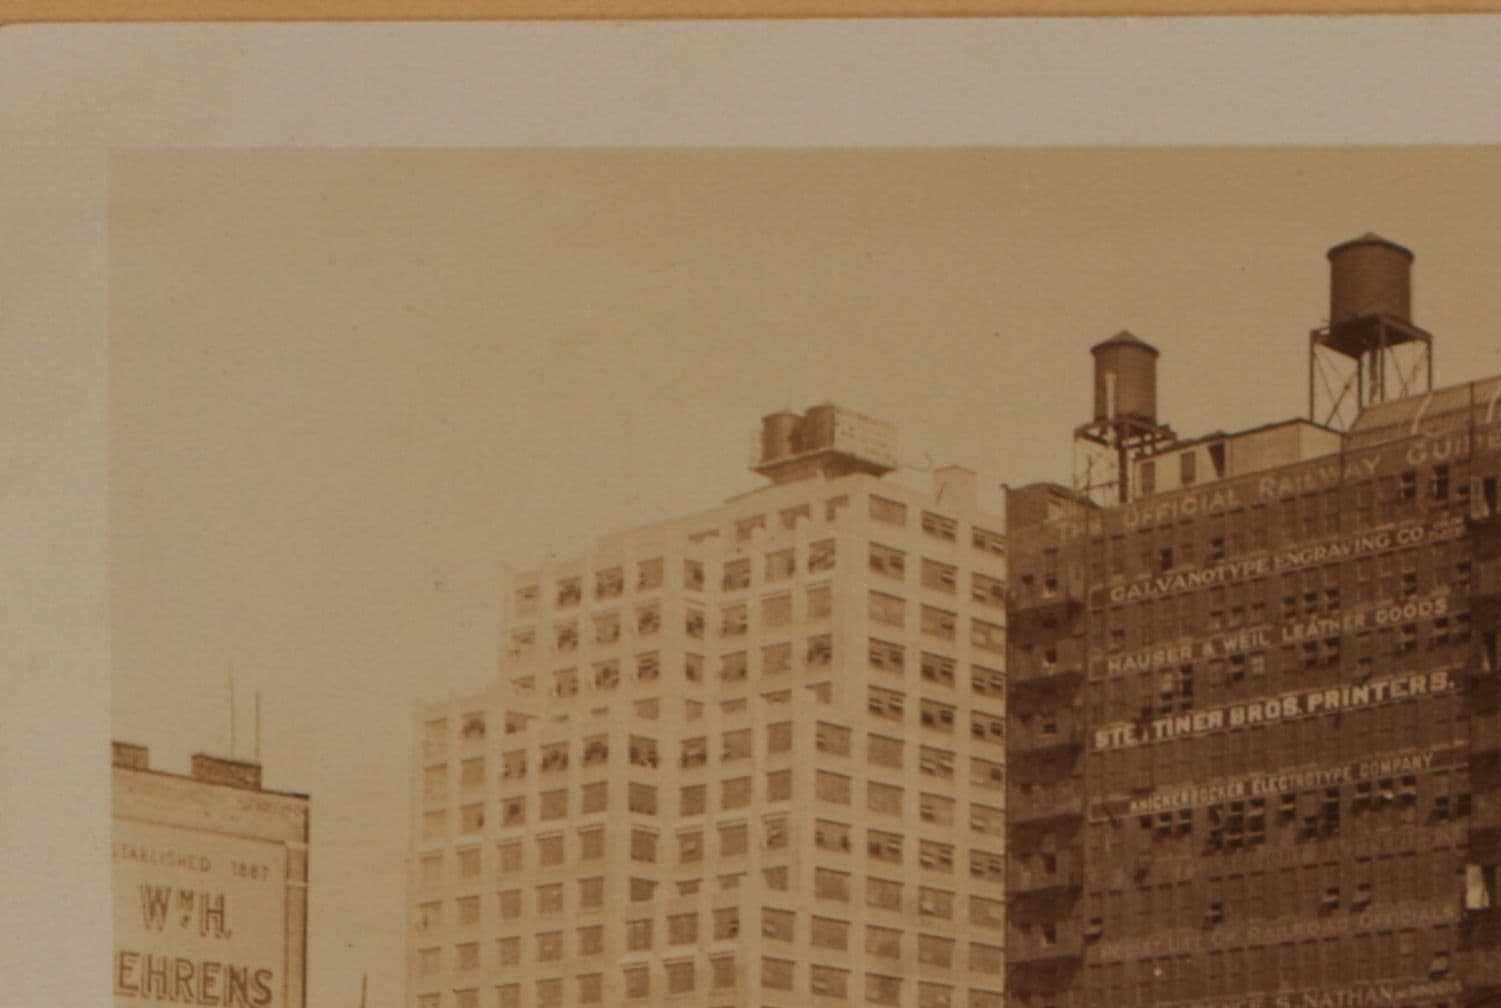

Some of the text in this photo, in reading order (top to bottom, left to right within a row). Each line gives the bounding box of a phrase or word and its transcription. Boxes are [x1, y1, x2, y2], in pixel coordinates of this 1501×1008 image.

[1274, 532, 1391, 572] ENGRAVING
[1375, 597, 1449, 627] GOODS
[1095, 711, 1226, 753] STETINER
[1360, 752, 1434, 779] COMPANY
